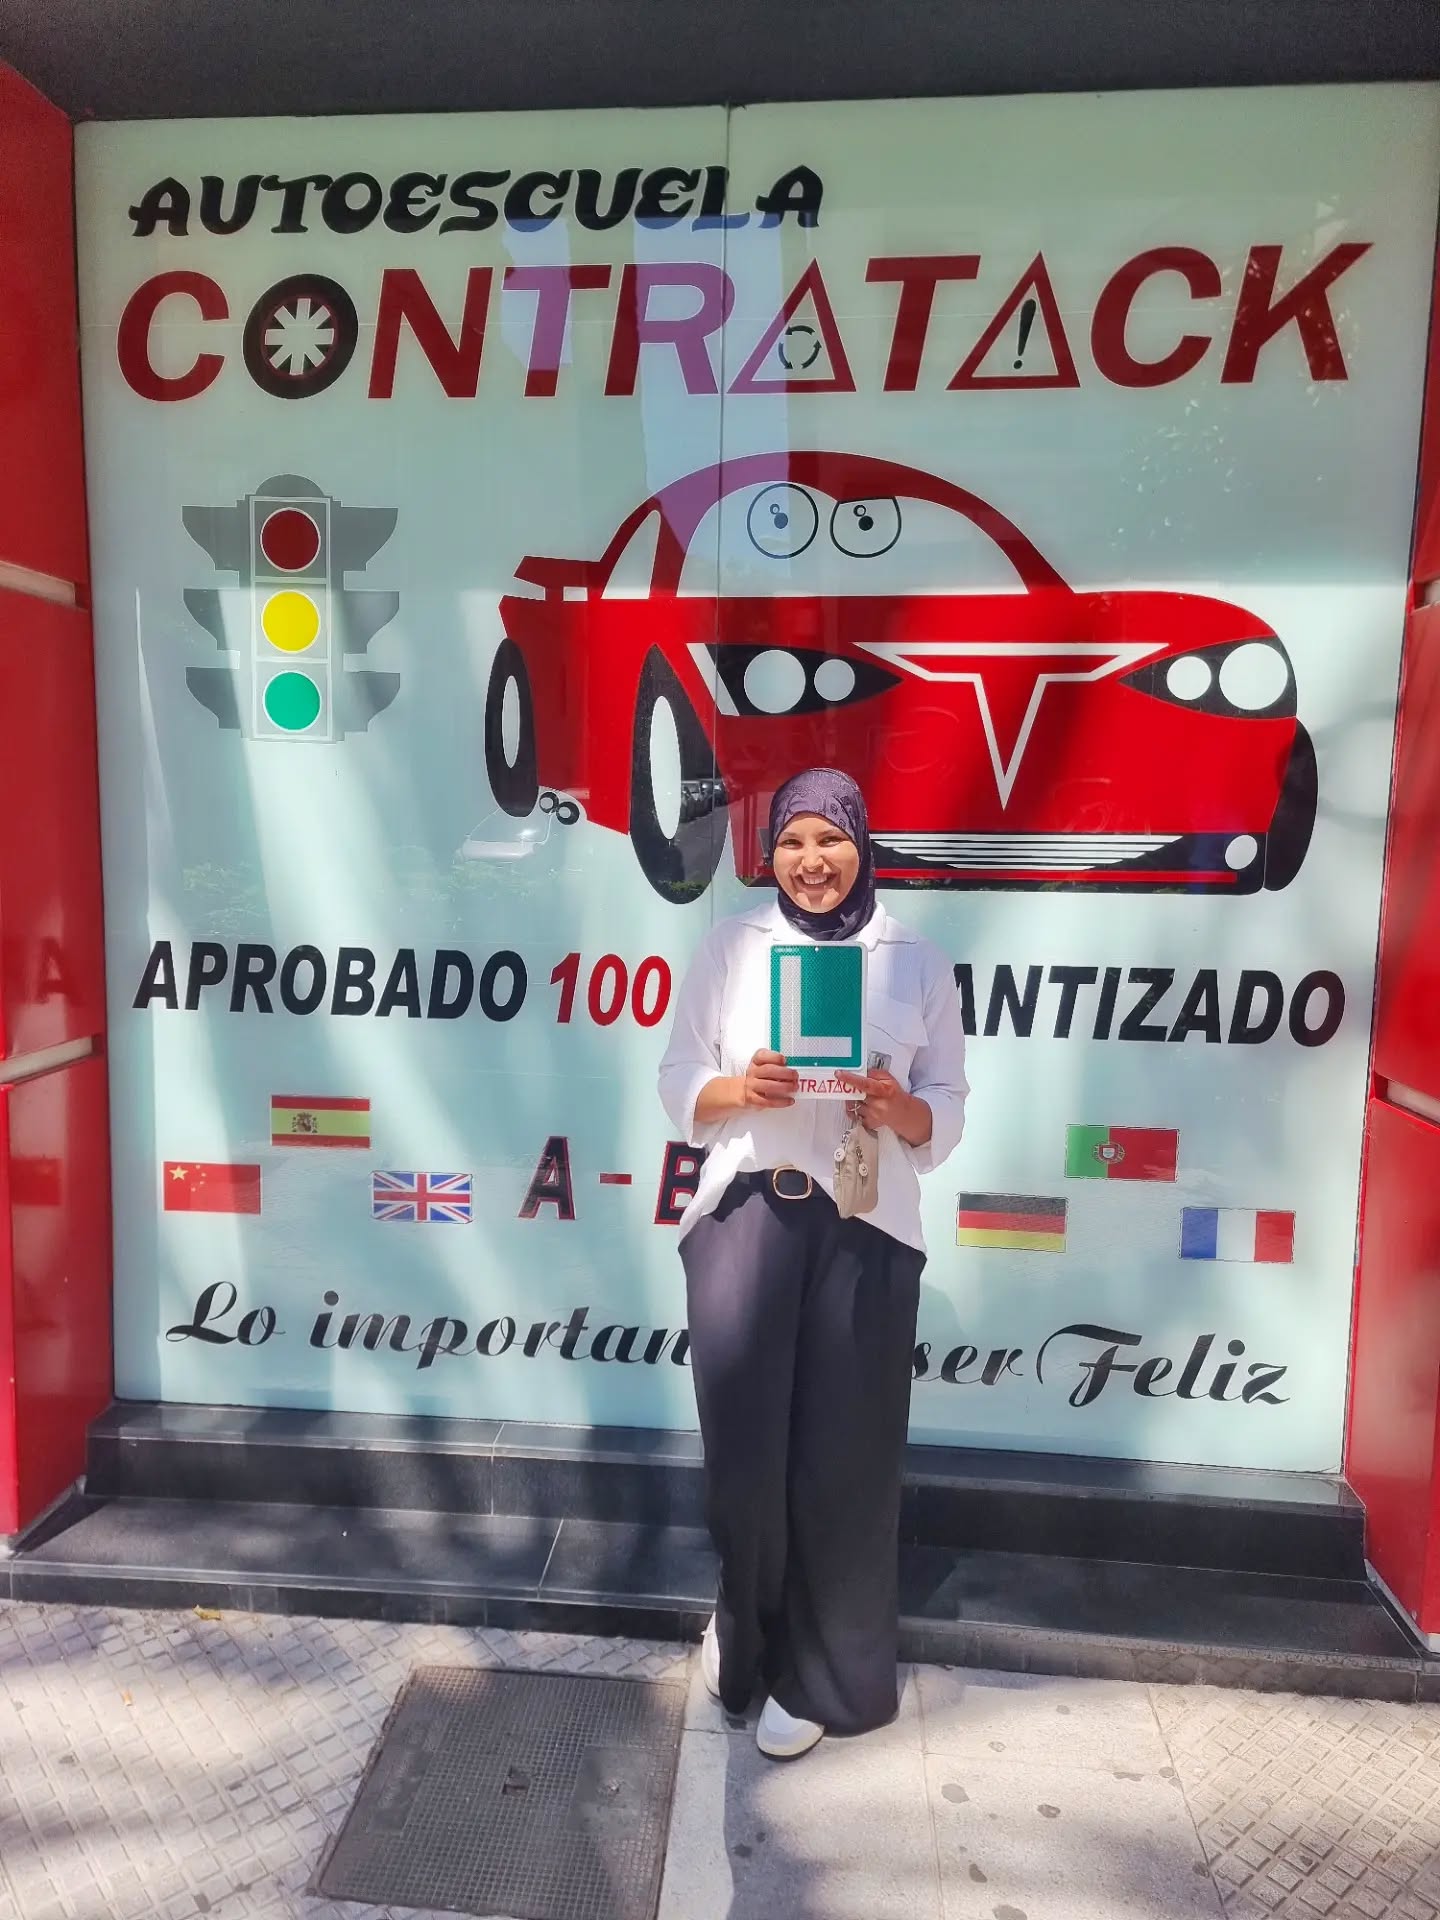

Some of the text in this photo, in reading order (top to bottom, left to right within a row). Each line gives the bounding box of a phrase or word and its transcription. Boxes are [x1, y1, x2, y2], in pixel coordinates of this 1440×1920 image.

[128, 164, 824, 237] AUTOESCUELA
[117, 242, 1374, 402] CONTRATACK
[132, 940, 528, 1022] APROBADO
[550, 952, 672, 1027] 100
[780, 956, 852, 1057] L
[165, 1281, 286, 1346] Lo
[309, 1290, 692, 1370] importan
[1035, 1323, 1291, 1407] Feliz
